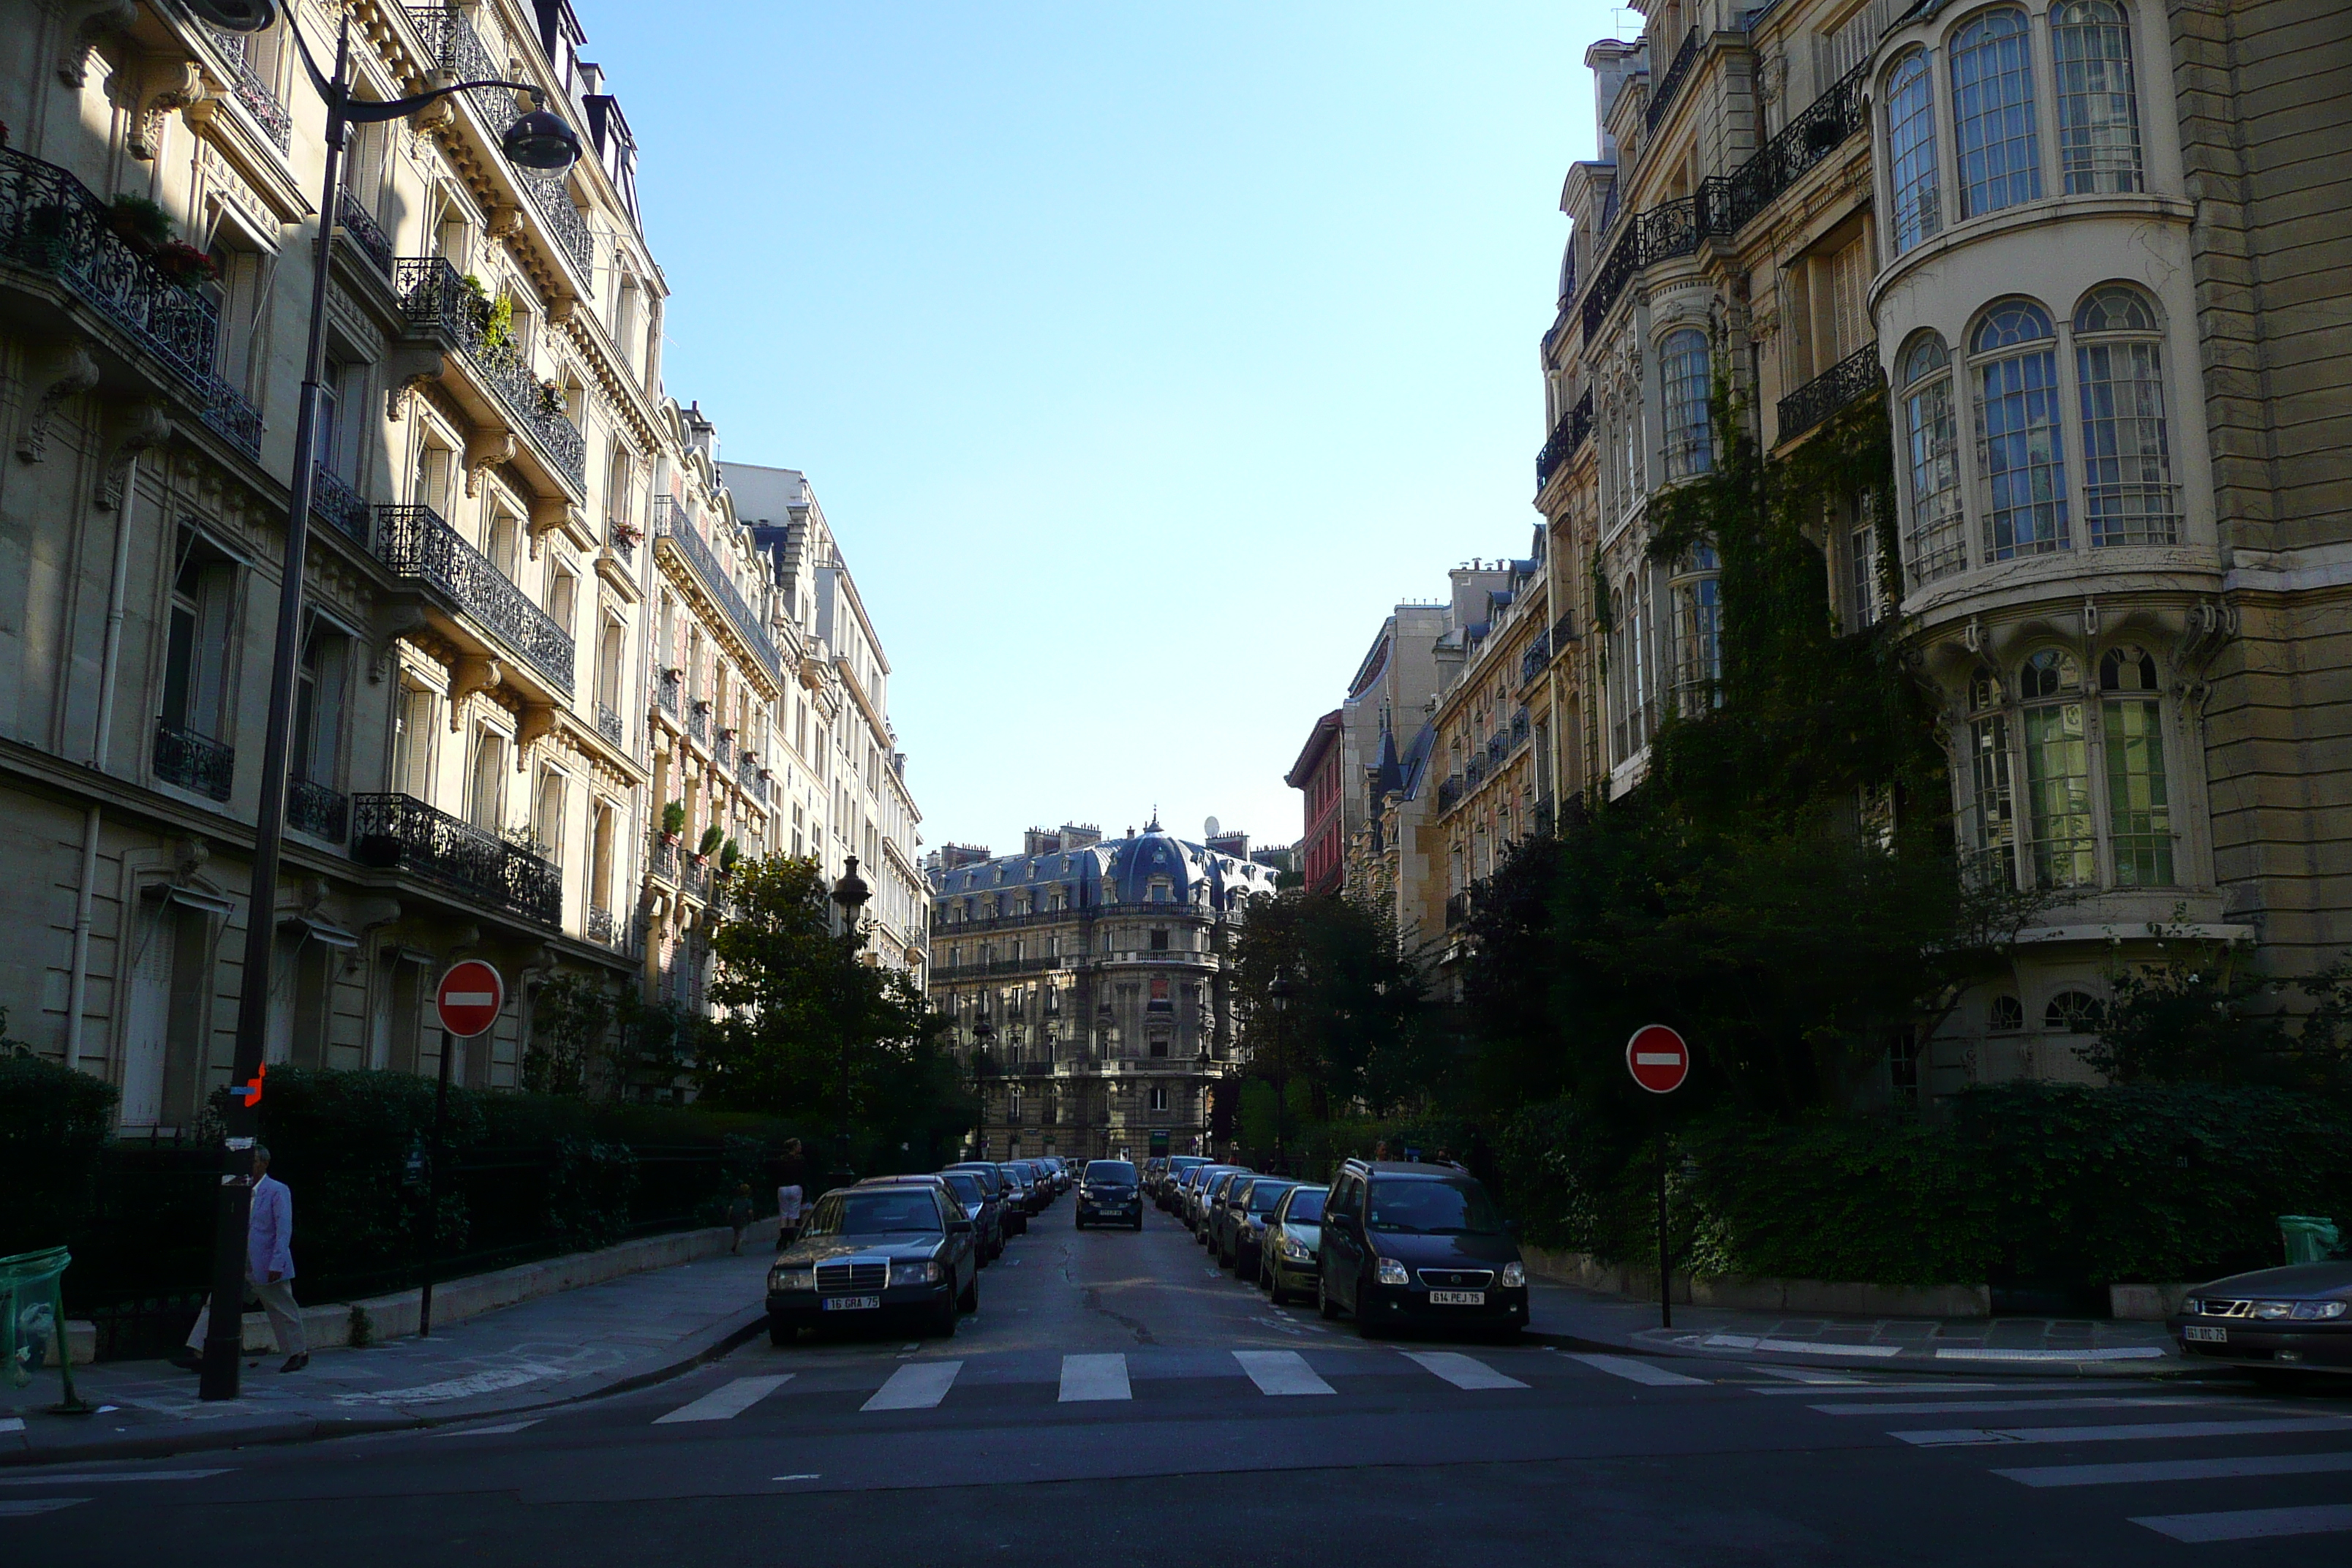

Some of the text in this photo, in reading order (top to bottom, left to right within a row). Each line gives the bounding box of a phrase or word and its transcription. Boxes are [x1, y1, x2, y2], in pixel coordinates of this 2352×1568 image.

[2176, 1156, 2188, 1168] 51
[832, 1297, 878, 1308] 16 GRA 75
[1433, 1292, 1480, 1303] 614 PEJ 75
[2215, 1329, 2225, 1340] 75
